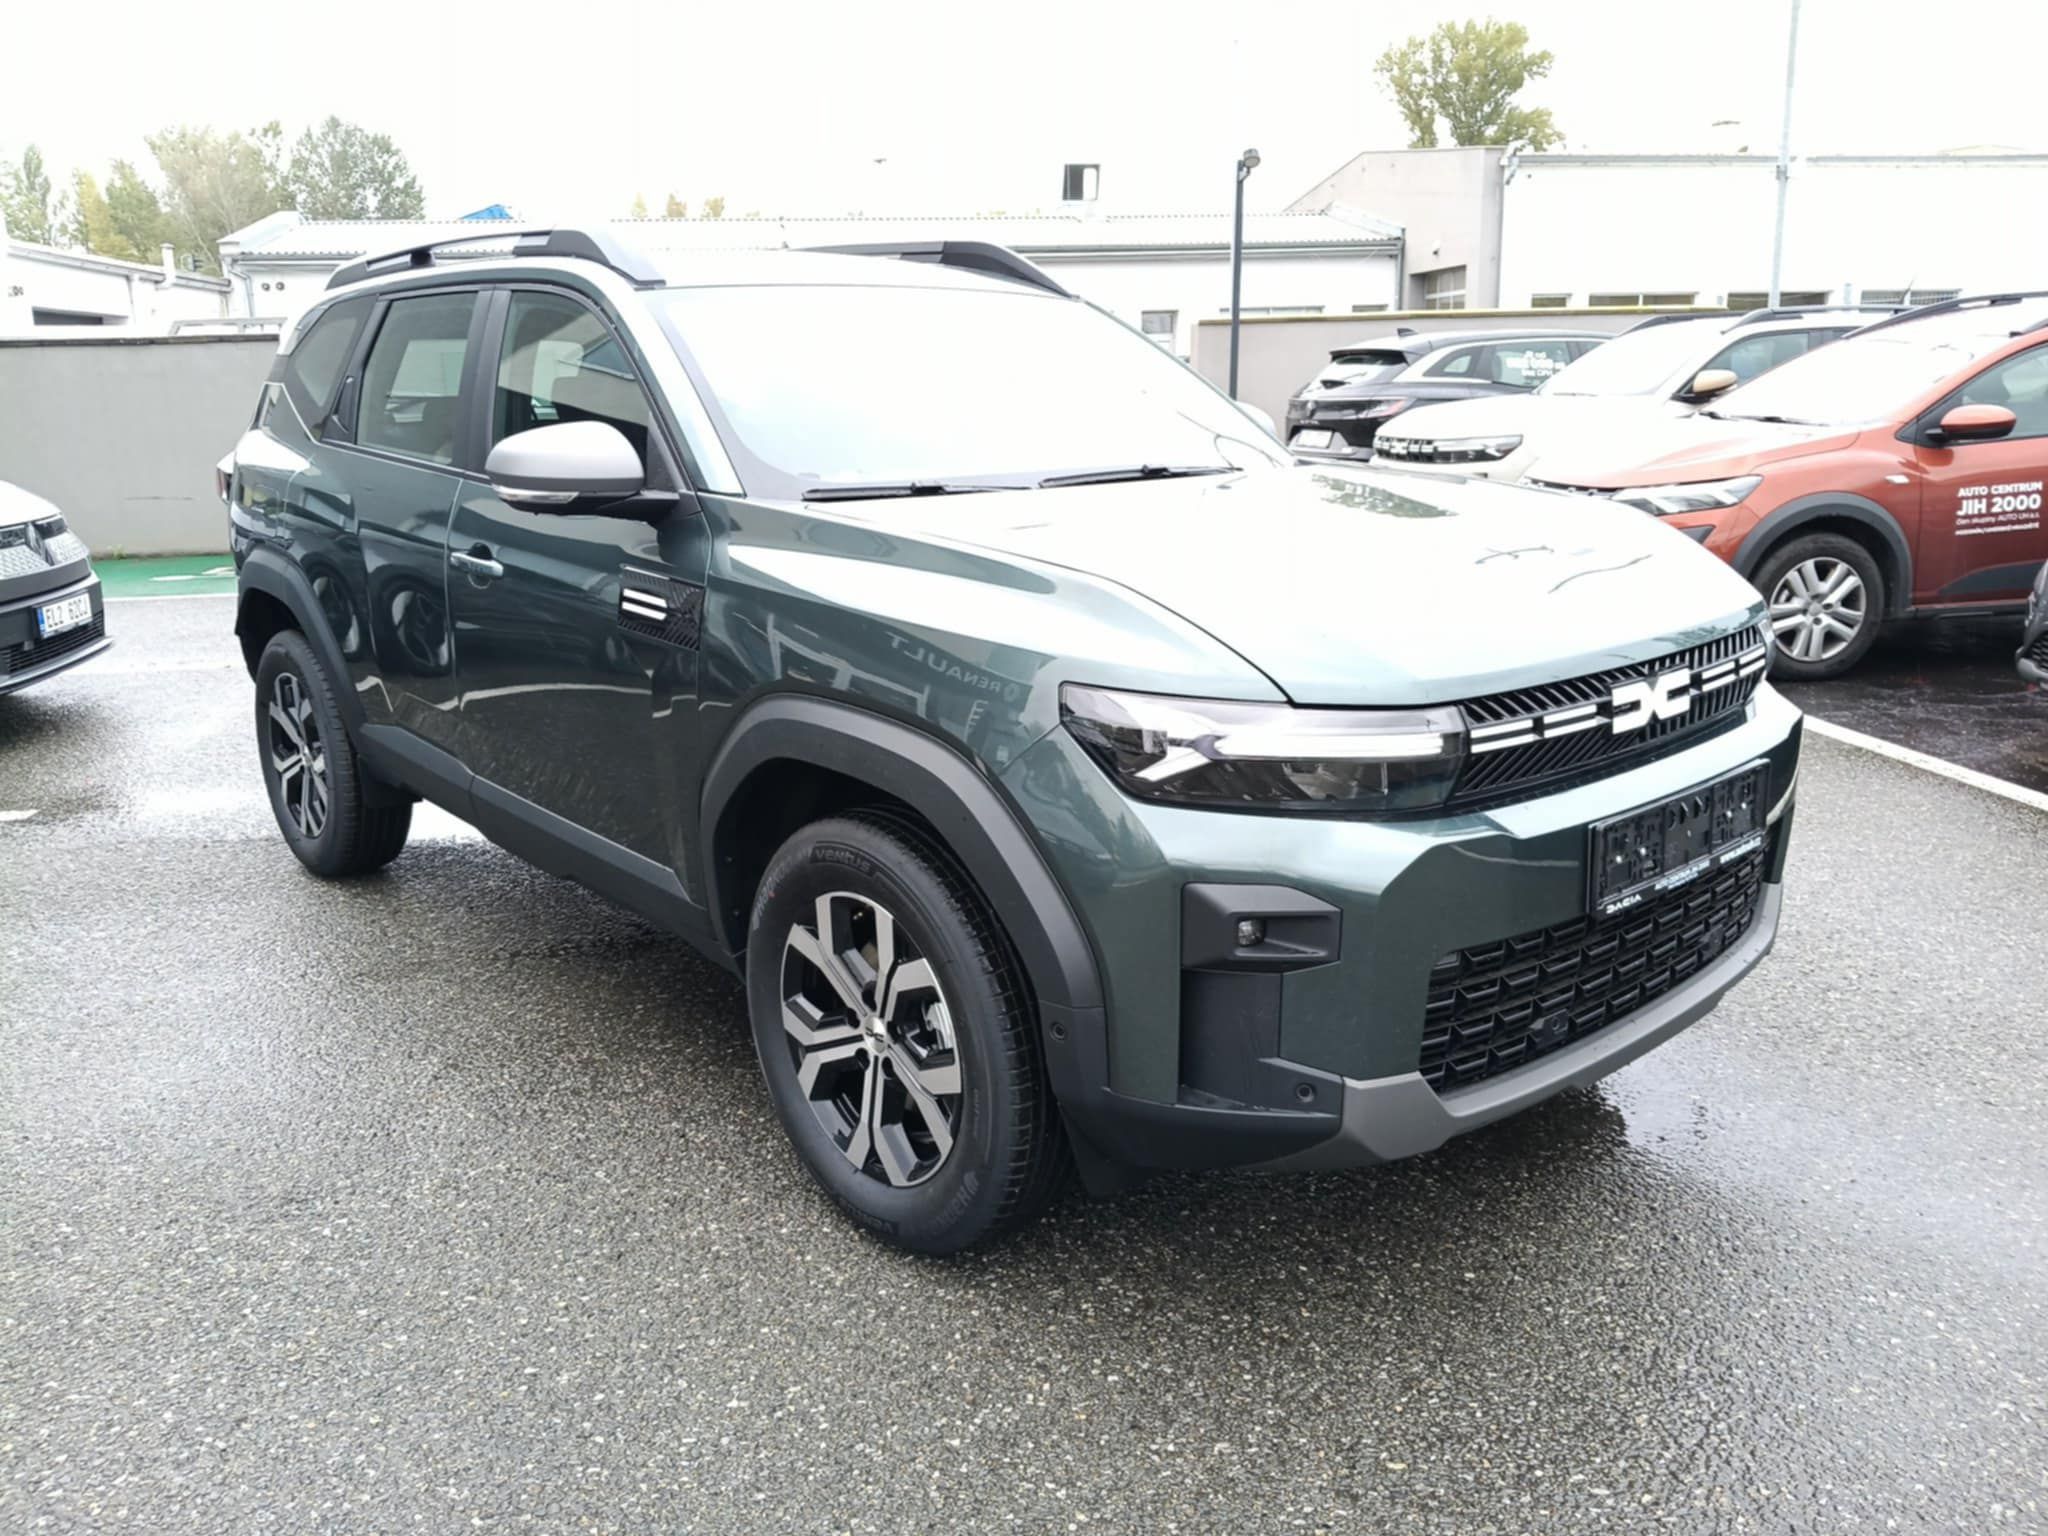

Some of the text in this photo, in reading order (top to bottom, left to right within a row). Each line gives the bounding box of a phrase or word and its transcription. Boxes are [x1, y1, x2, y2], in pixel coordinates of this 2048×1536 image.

[1958, 481, 2043, 498] AUTO CENTRUM
[1956, 494, 2041, 516] JIH 2000
[1605, 893, 1642, 915] DACIA
